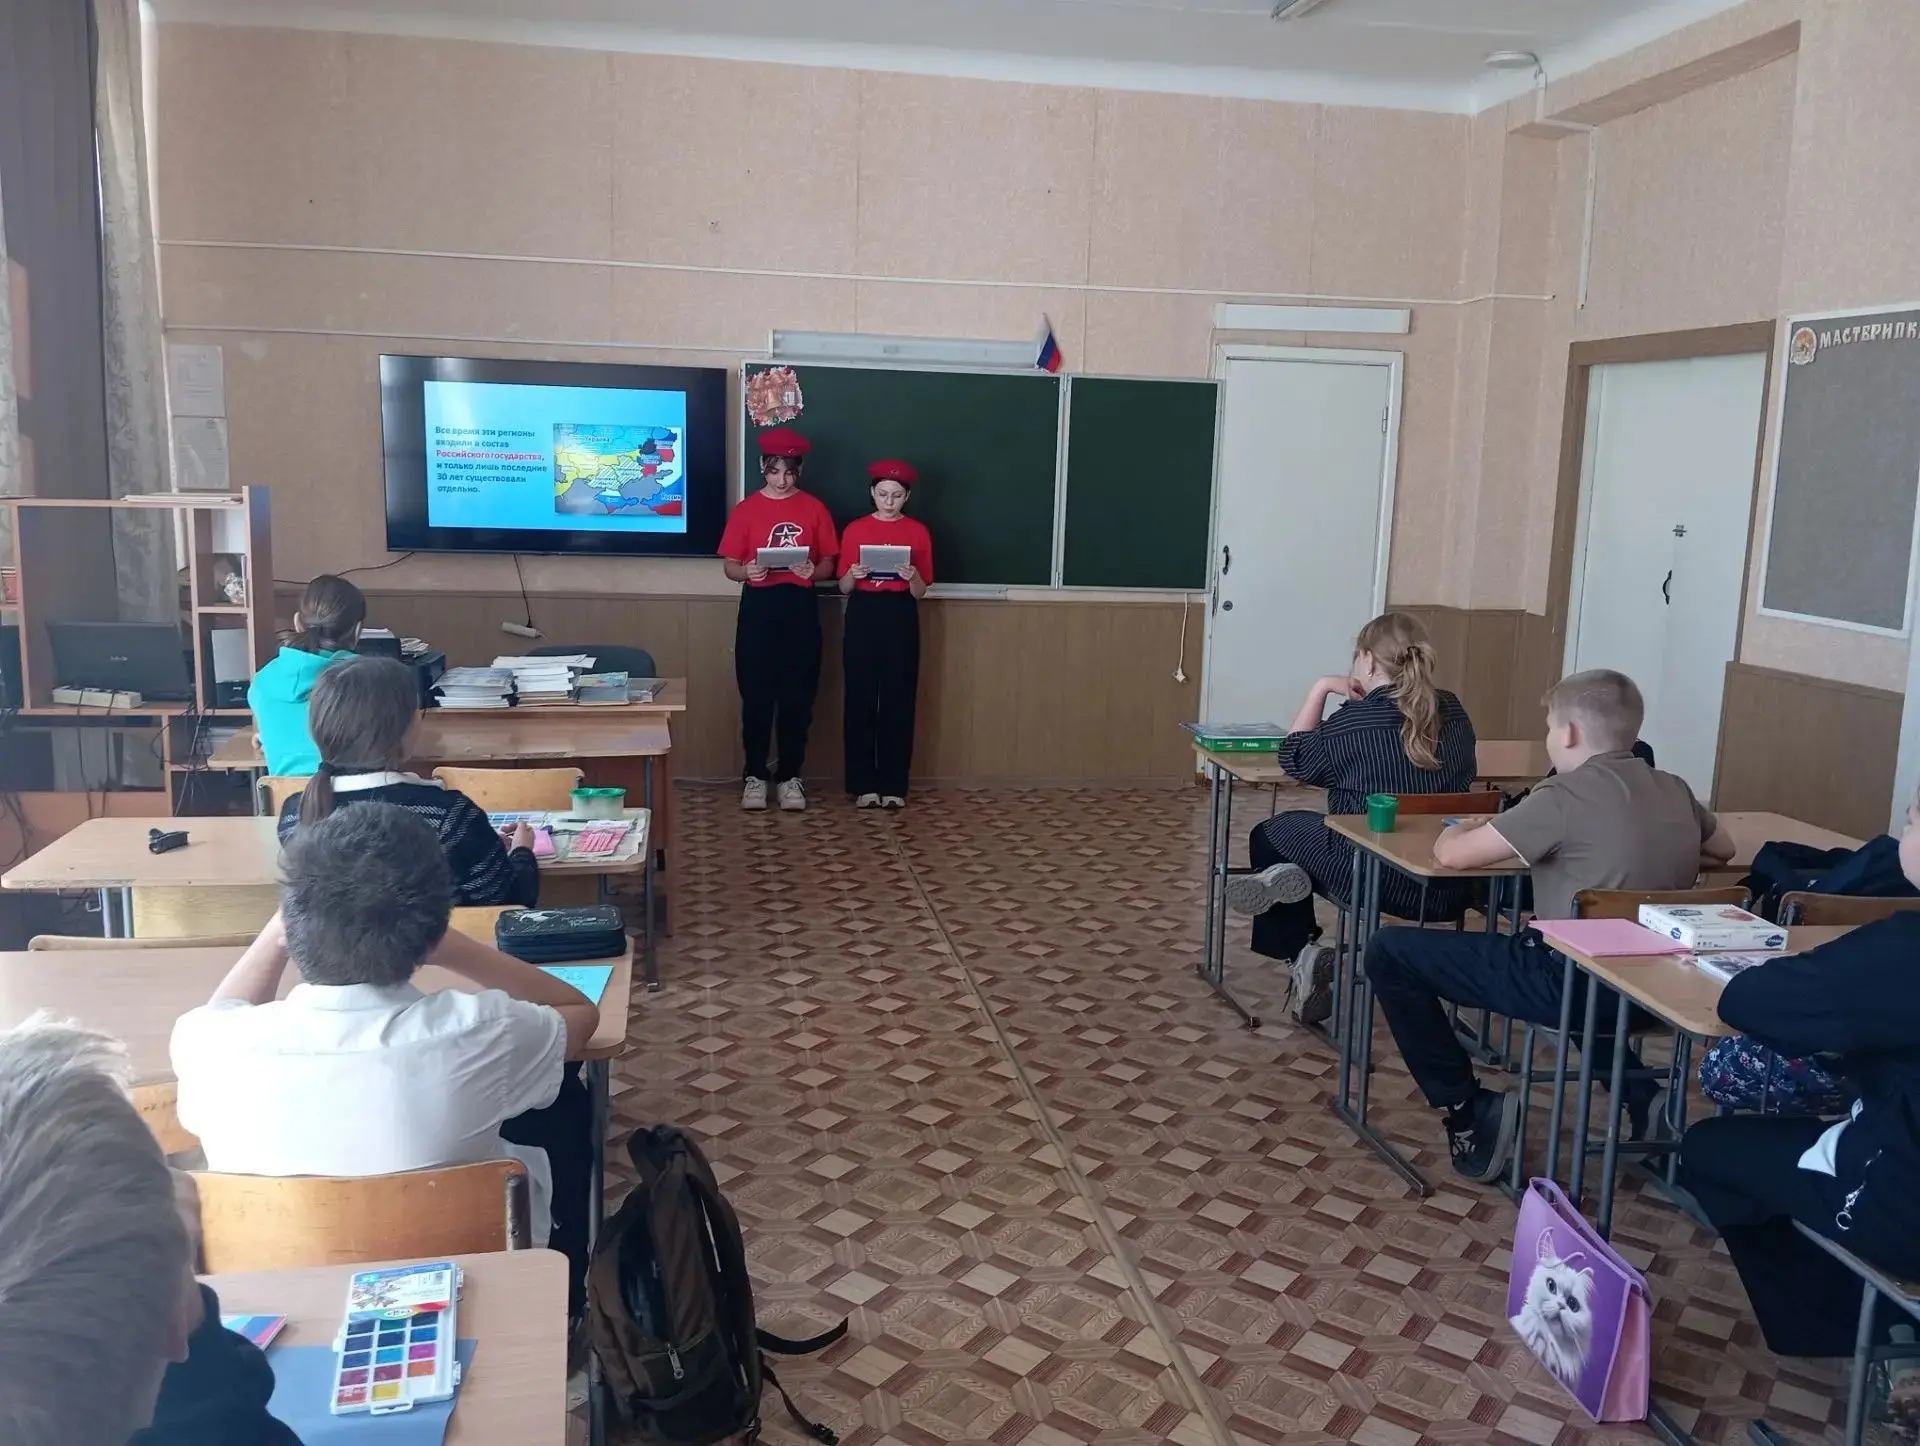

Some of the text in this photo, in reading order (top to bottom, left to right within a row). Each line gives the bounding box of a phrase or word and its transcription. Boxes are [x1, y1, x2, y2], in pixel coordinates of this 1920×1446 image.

[1820, 321, 1920, 349] МАСТЕРИЛК
[435, 426, 450, 434] Все
[452, 427, 480, 437] время
[498, 429, 535, 438] регионы
[435, 439, 473, 448] входили
[481, 440, 510, 448] состав
[436, 449, 491, 459] Российского
[444, 462, 474, 470] только
[475, 462, 499, 471] лишь
[501, 464, 548, 473] последние
[437, 472, 526, 483] 30 лет существовали
[437, 485, 481, 493] отдельно.
